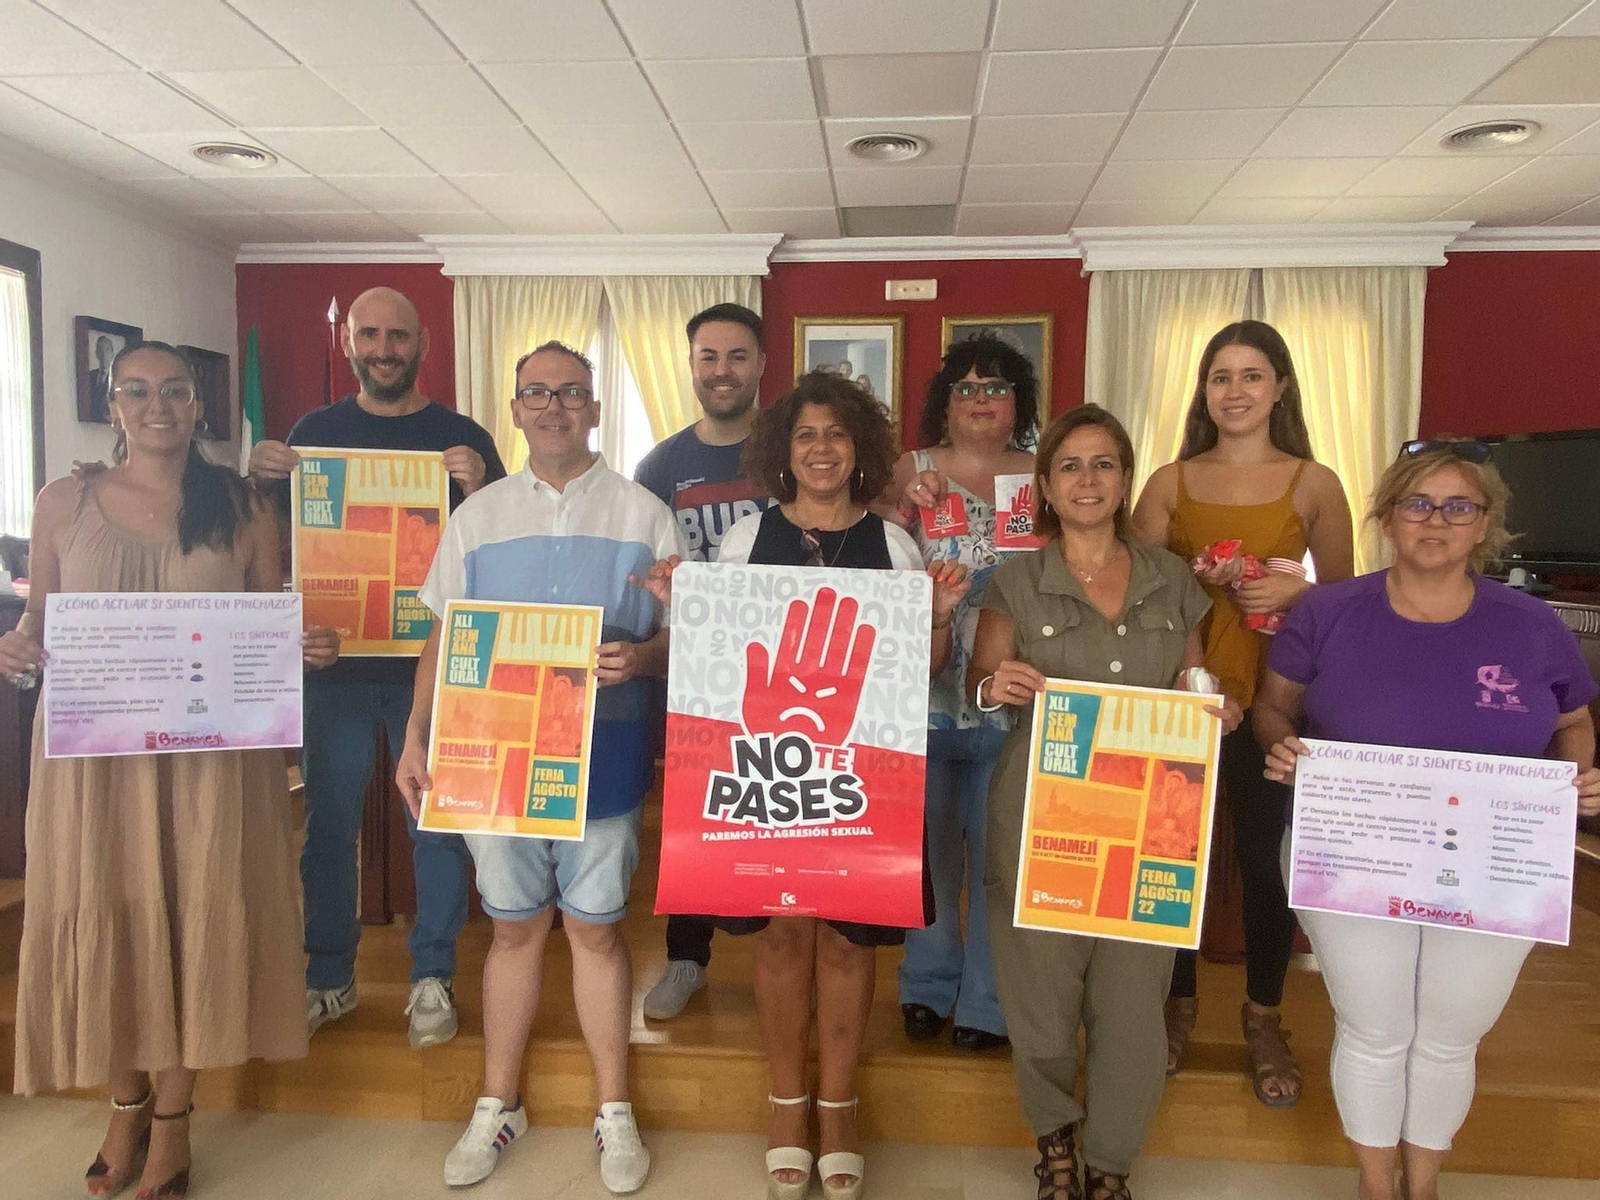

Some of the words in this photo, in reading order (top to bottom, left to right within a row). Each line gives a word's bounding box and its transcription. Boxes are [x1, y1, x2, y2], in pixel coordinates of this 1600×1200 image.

[1006, 523, 1032, 533] PASE
[1011, 515, 1028, 525] NO
[750, 572, 799, 602] NO
[101, 598, 148, 611] ACTUAR
[165, 598, 211, 610] SIENTES
[214, 599, 230, 611] UN
[233, 595, 299, 611] PINCHAZO?
[397, 609, 435, 621] AGOST
[454, 614, 473, 628] XLI
[714, 599, 763, 630] NO
[397, 622, 411, 634] 22
[451, 656, 480, 670] CULT
[1048, 695, 1070, 712] XLI
[735, 736, 813, 781] NO
[815, 746, 849, 772] TE
[1044, 742, 1078, 759] CULT
[1043, 756, 1078, 774] URAL
[1355, 750, 1404, 766] ACTUAR
[1407, 755, 1419, 767] SI
[1422, 756, 1472, 772] SIENTES
[1476, 761, 1494, 774] UN
[1498, 764, 1574, 780] PINCHAZO?
[534, 767, 565, 783] FERIA
[532, 782, 577, 798] AGOSTO
[531, 797, 546, 810] 22
[708, 774, 863, 824] PASES
[1490, 799, 1508, 810] LOS
[1512, 800, 1560, 815] SÍNTOMAS
[702, 830, 755, 842] PAREMOS
[758, 830, 771, 839] LA
[773, 827, 829, 839] AGRESIÓN
[831, 826, 873, 837] SEXUAL
[1032, 834, 1098, 856] BENAMEJÍ
[1141, 868, 1177, 887] FERIA
[1139, 886, 1191, 904] AGOSTO
[1138, 900, 1155, 915] 22
